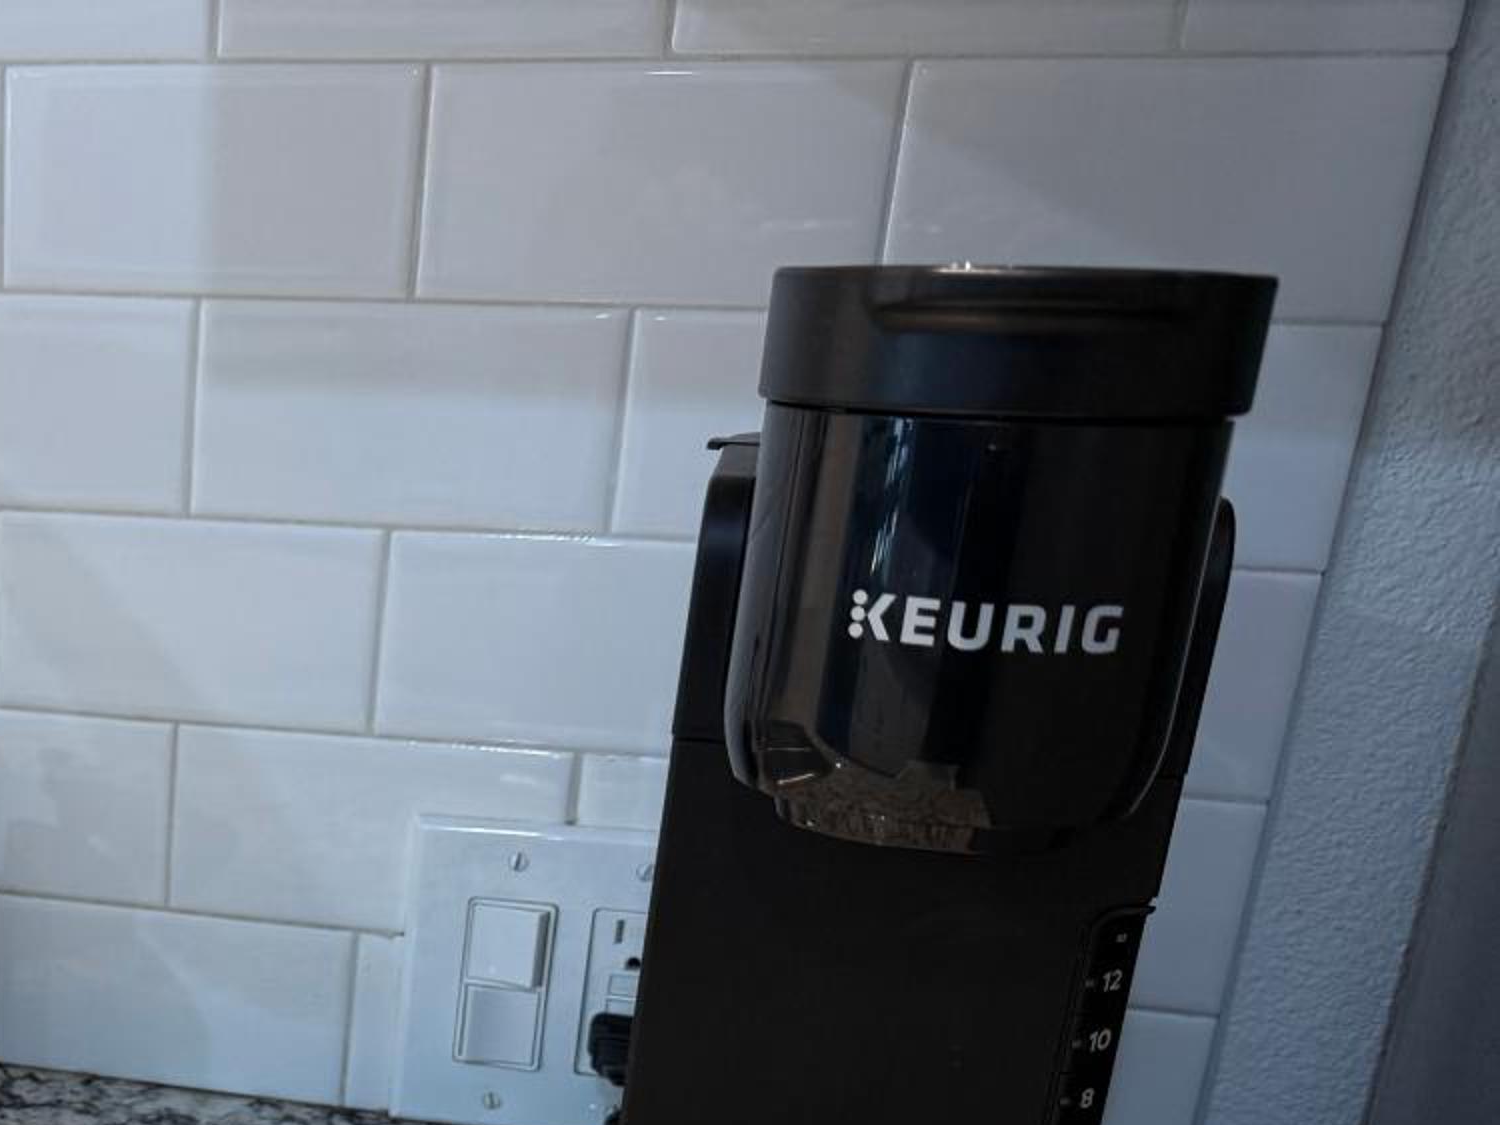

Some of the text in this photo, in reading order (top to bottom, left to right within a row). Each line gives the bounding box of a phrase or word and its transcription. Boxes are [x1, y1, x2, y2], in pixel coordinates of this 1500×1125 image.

[848, 589, 1124, 654] KEURIG
[1102, 967, 1123, 992] 12
[1089, 1028, 1111, 1053] 10
[1079, 1088, 1095, 1109] 8
